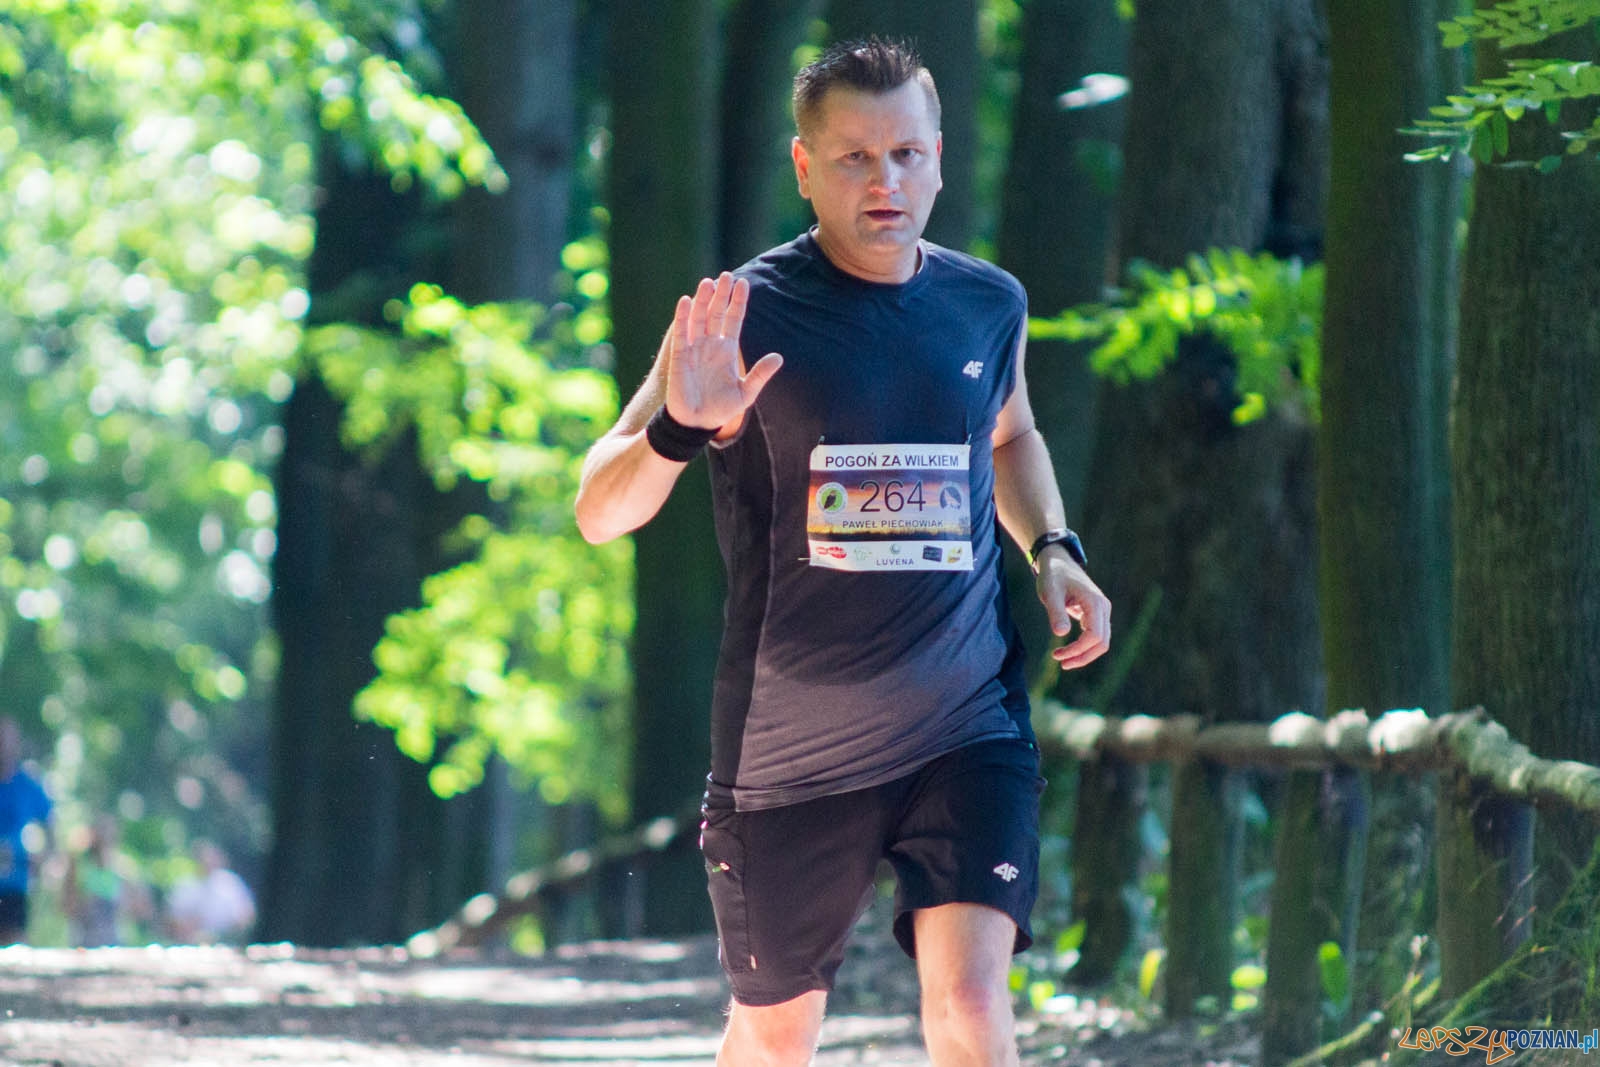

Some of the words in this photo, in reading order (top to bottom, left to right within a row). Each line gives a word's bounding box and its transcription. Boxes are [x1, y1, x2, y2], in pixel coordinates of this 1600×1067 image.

[963, 360, 984, 378] 4F
[825, 452, 877, 467] POGOŃ
[882, 455, 901, 467] ZA
[904, 455, 959, 467] WILKIEM
[860, 480, 926, 512] 264
[842, 520, 877, 529] PAWEŁ
[881, 519, 943, 528] PIECHOWIAK
[876, 558, 914, 566] LUVENA
[993, 863, 1019, 882] 4F
